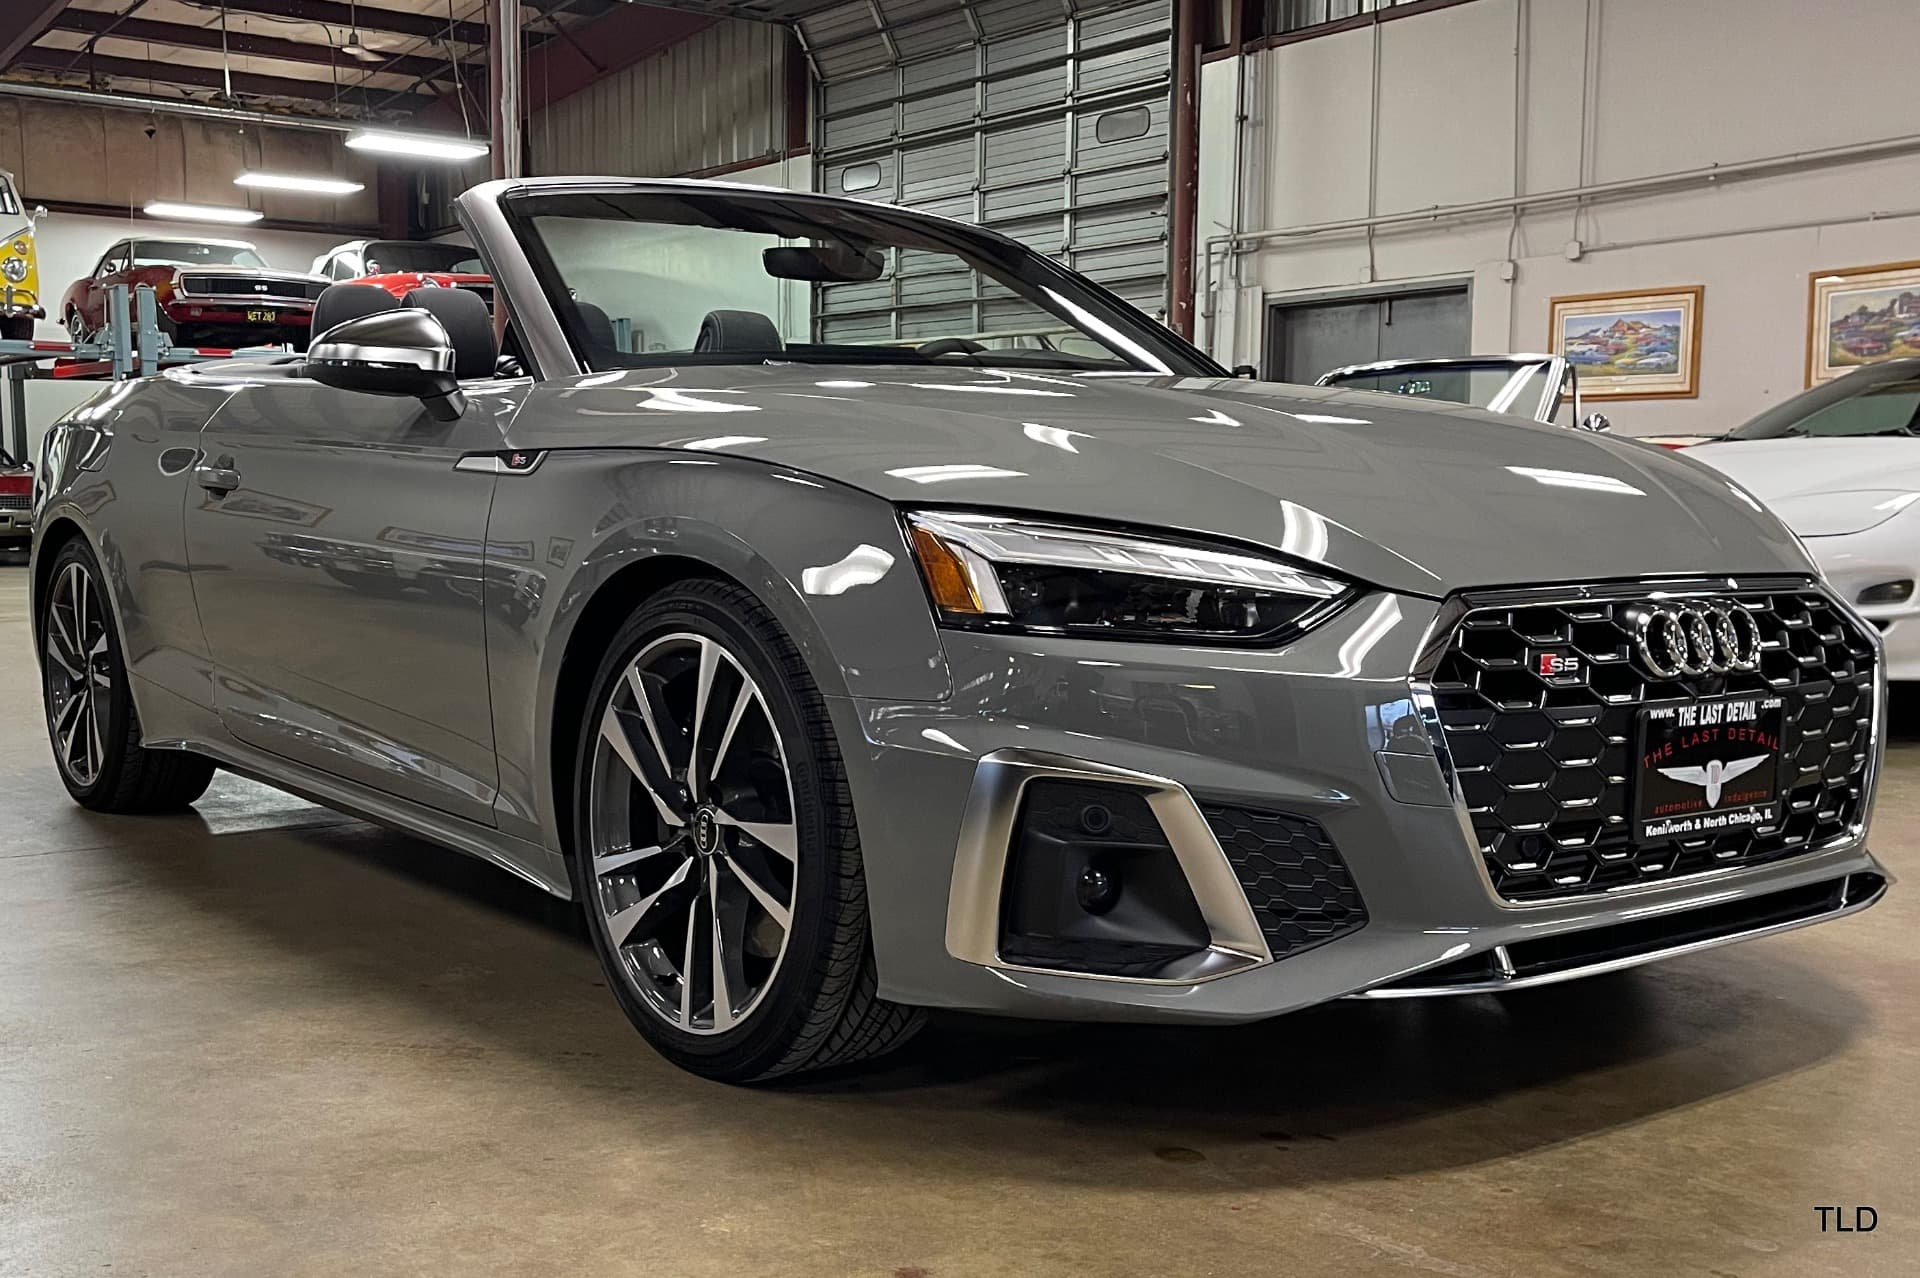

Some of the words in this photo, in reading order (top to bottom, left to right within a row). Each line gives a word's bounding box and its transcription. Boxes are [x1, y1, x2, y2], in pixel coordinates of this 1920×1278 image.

[1650, 708, 1676, 720] www.
[1678, 706, 1697, 727] THE
[1700, 704, 1724, 725] LAST
[1726, 700, 1757, 722] DETAIL
[1760, 698, 1782, 710] .com
[1643, 742, 1673, 768] THE
[1681, 728, 1720, 749] LAST
[1728, 728, 1779, 750] DETAIL
[1694, 818, 1701, 830] &
[1703, 815, 1728, 829] North
[1764, 808, 1773, 820] IL
